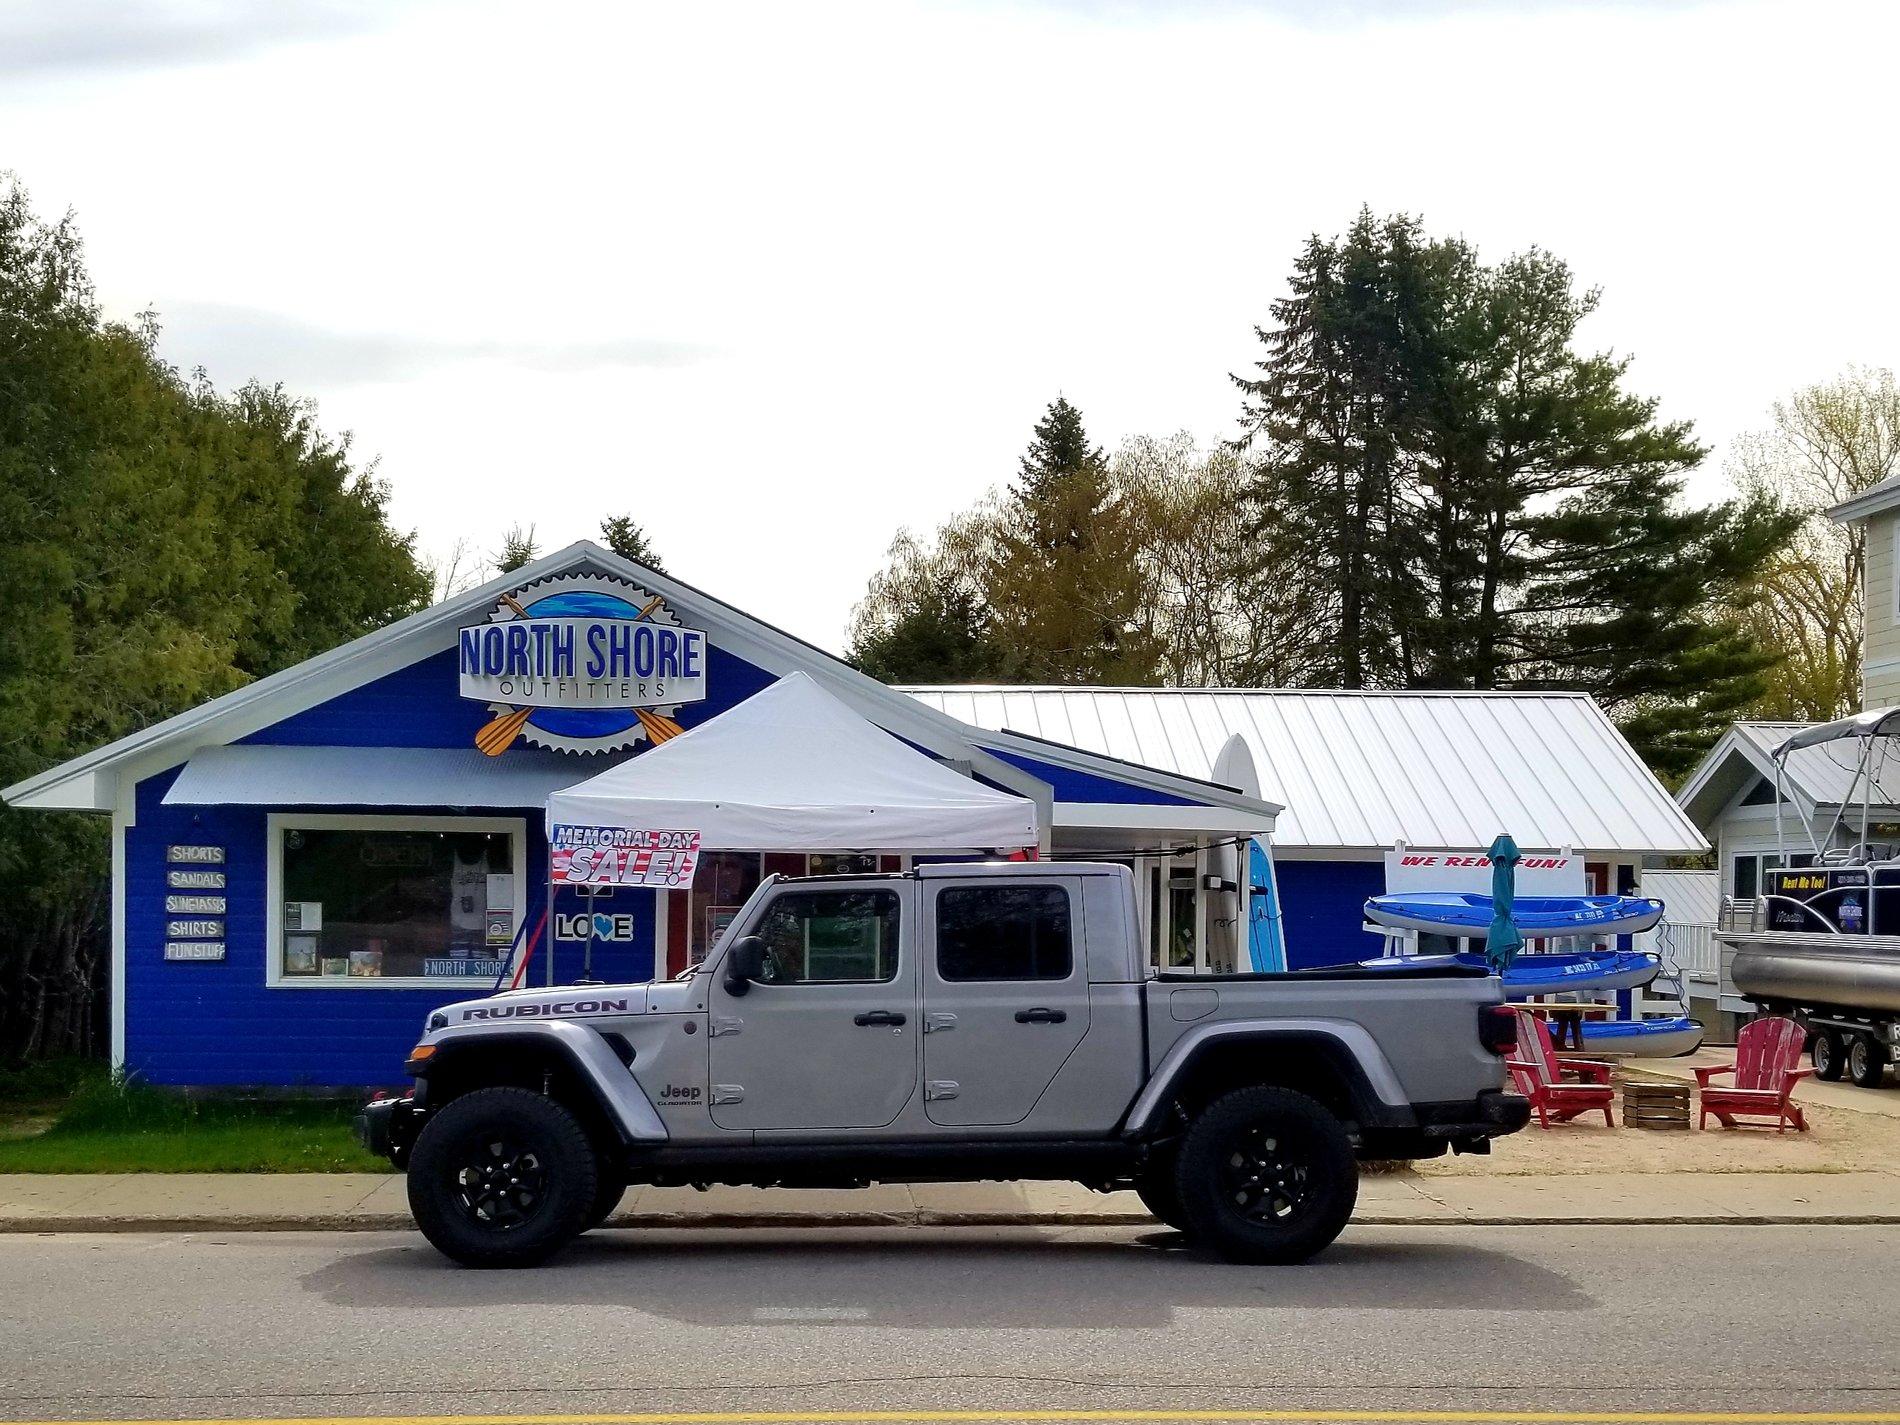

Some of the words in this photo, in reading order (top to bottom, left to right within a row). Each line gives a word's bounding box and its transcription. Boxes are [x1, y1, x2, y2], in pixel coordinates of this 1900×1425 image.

[460, 624, 575, 678] NORTH
[586, 624, 702, 679] SHORE
[499, 681, 666, 699] OUTFITTERS
[556, 826, 654, 848] MEMORIAL
[658, 832, 696, 850] DAY
[172, 846, 222, 861] SHORTS
[1400, 855, 1439, 867] WE
[1443, 856, 1492, 867] REN
[565, 846, 689, 886] SALE!
[171, 872, 225, 888] SANDALS
[1782, 876, 1798, 889] Rent
[1811, 876, 1826, 889] Too!
[170, 921, 217, 936] SHIRTS
[431, 961, 466, 976] NORTH
[462, 999, 628, 1021] RUBICON
[660, 1084, 701, 1100] Jeep
